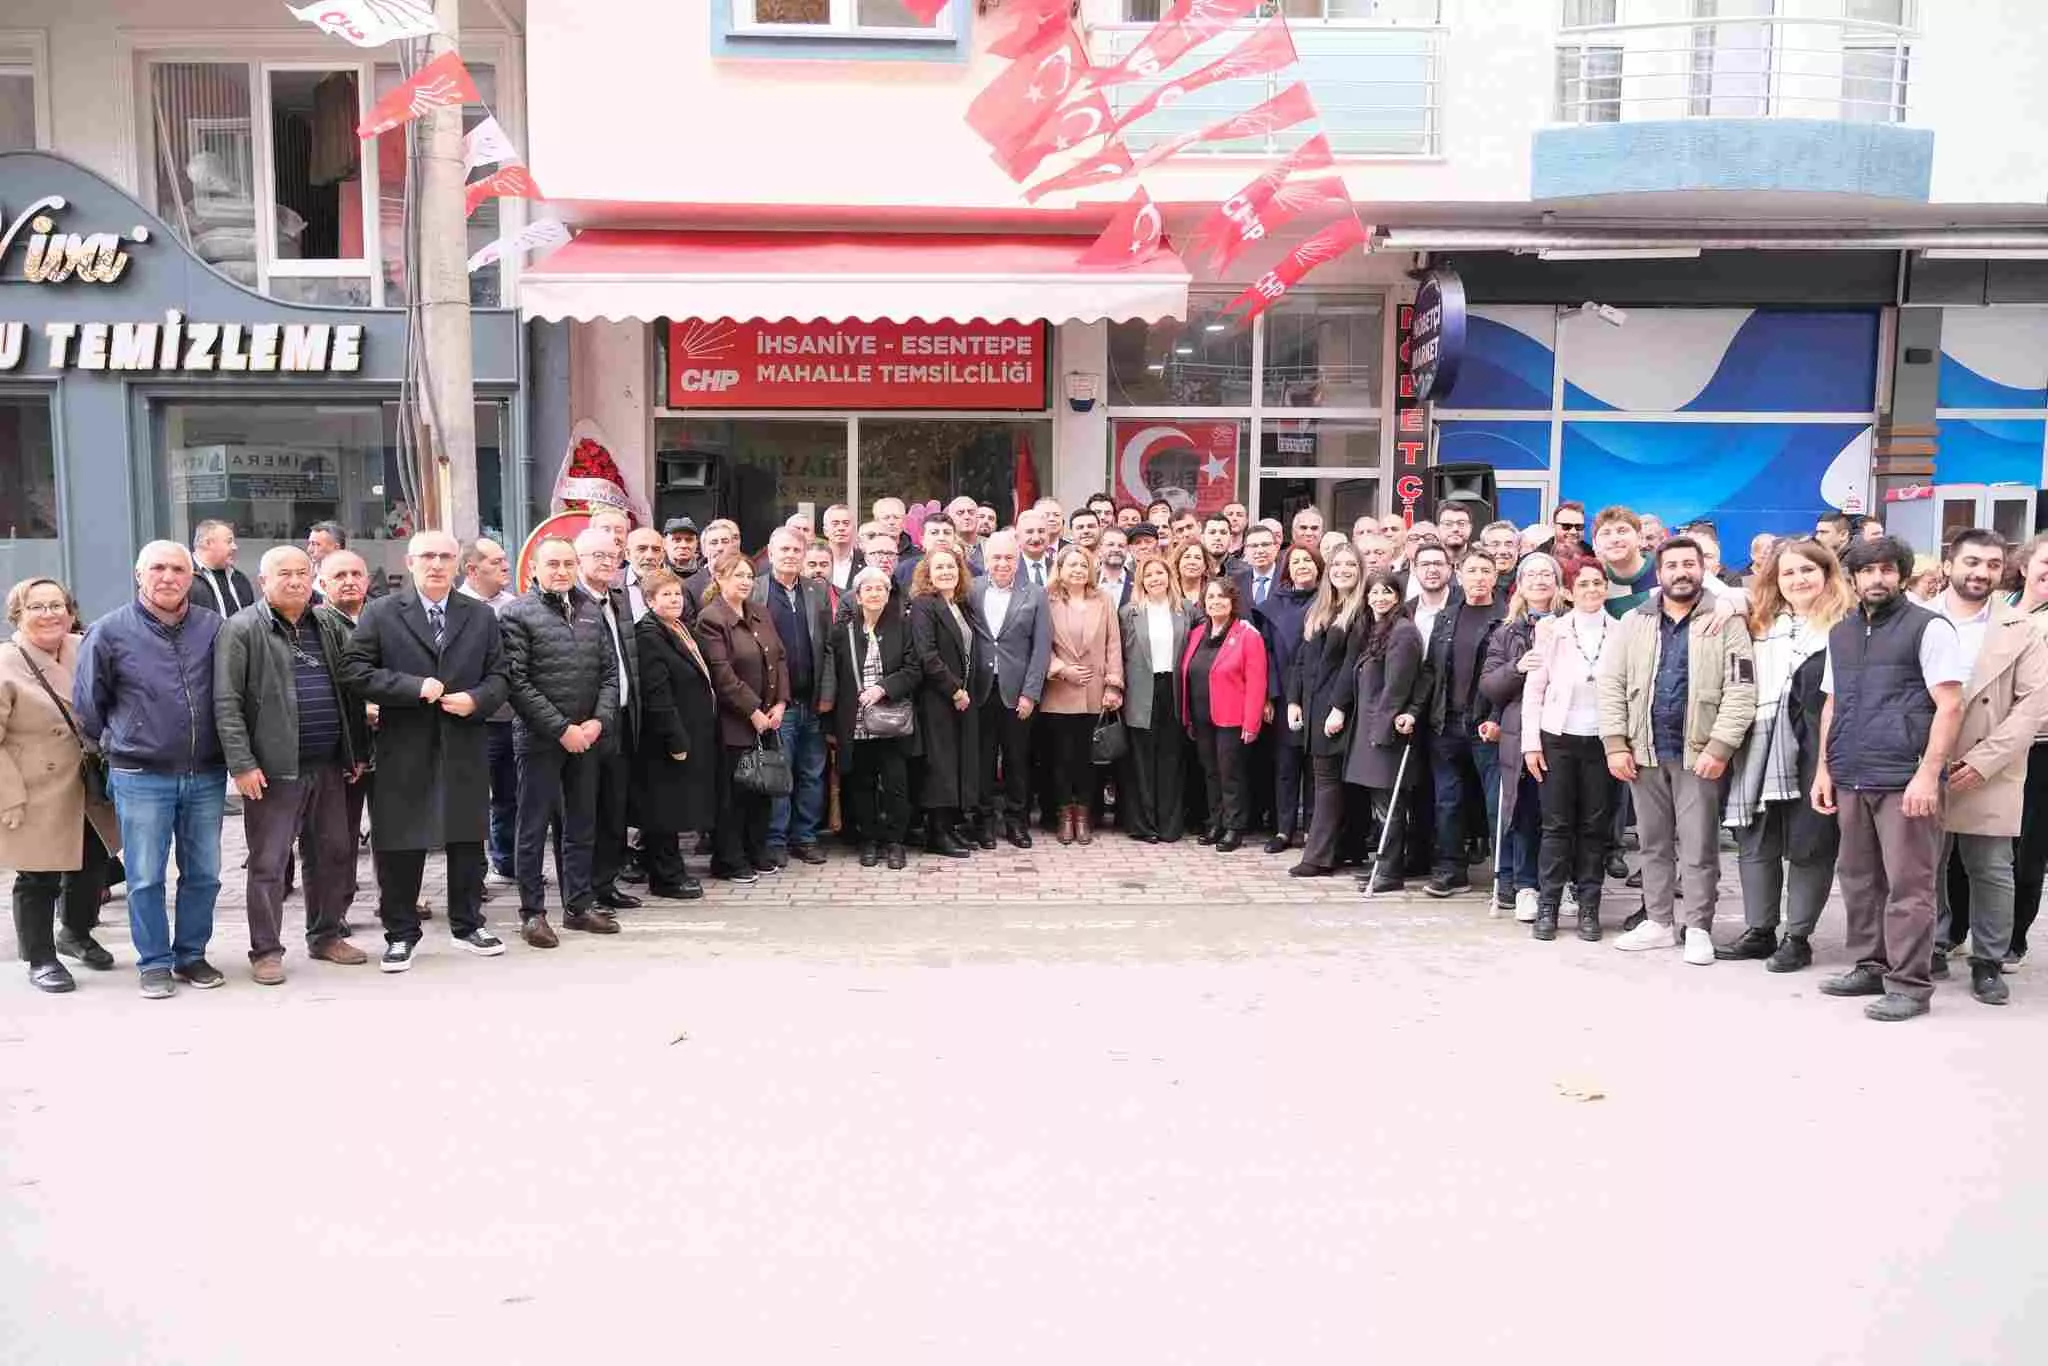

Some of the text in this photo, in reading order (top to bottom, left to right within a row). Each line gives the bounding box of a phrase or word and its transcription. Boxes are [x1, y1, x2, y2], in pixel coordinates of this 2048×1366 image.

[1221, 194, 1265, 241] CHP
[1255, 271, 1286, 298] CHP
[45, 308, 362, 371] TEMİZLEME
[756, 330, 877, 355] İHSANİYE
[902, 335, 1033, 355] ESENTEPE
[1411, 336, 1441, 371] MARKET
[680, 368, 740, 392] CHP
[756, 360, 1033, 384] MAHALLE TEMSİLCİLİĞİ
